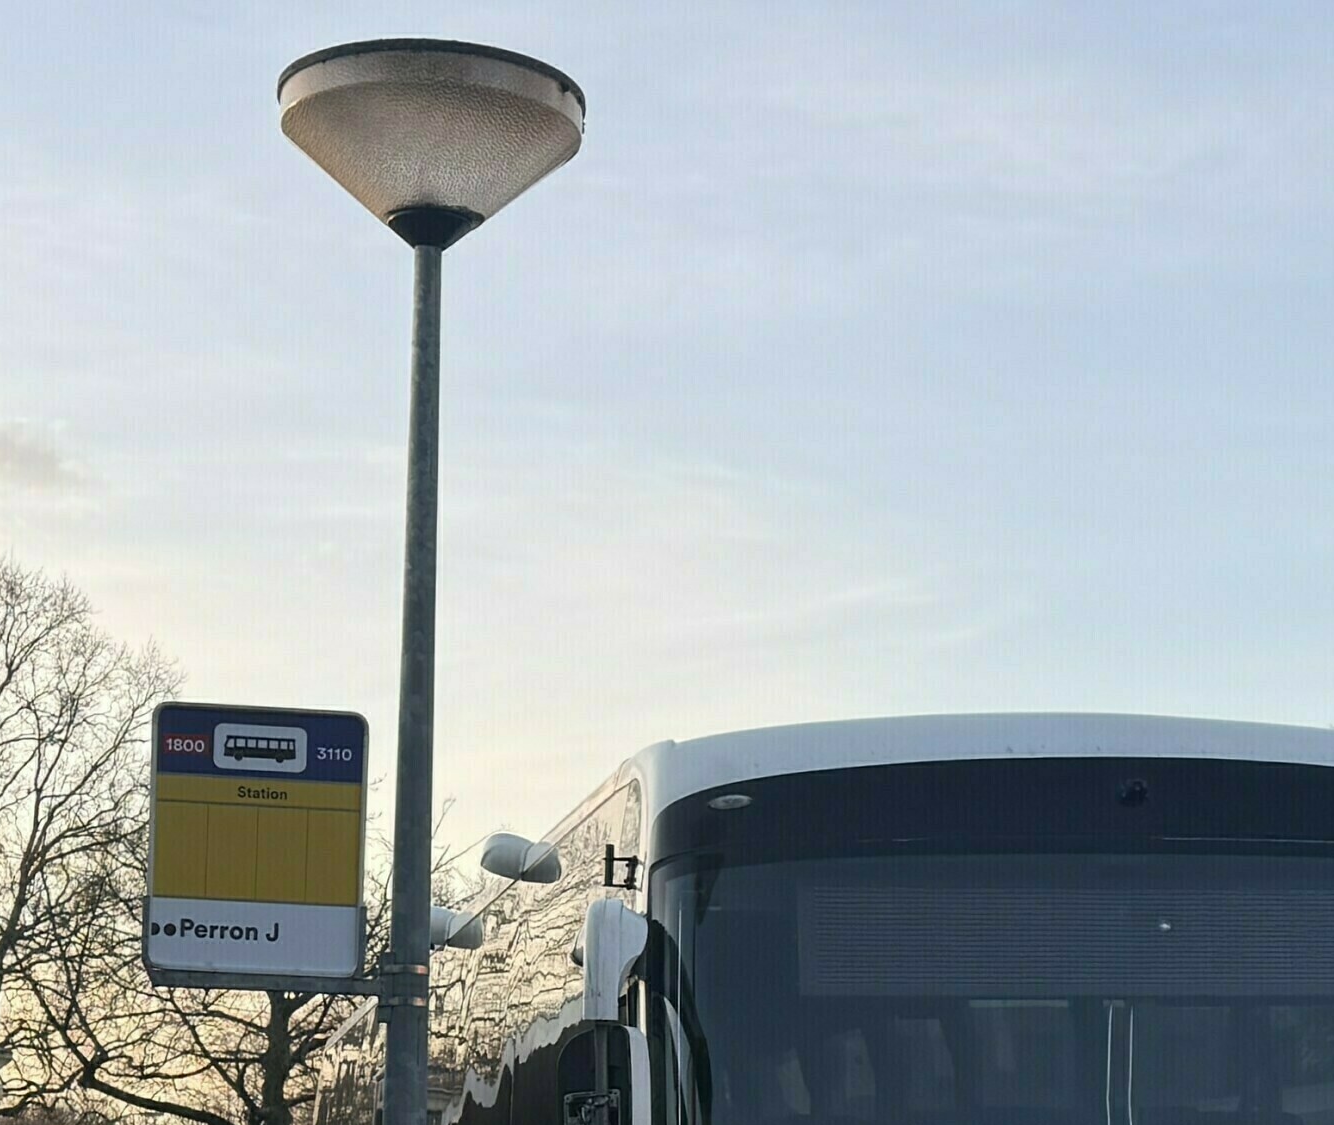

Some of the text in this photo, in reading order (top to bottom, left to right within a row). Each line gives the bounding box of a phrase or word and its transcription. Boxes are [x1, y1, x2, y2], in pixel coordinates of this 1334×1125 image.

[165, 737, 205, 753] 1800
[317, 747, 352, 762] 3110
[237, 786, 288, 800] Station
[179, 918, 280, 942] Perron J
